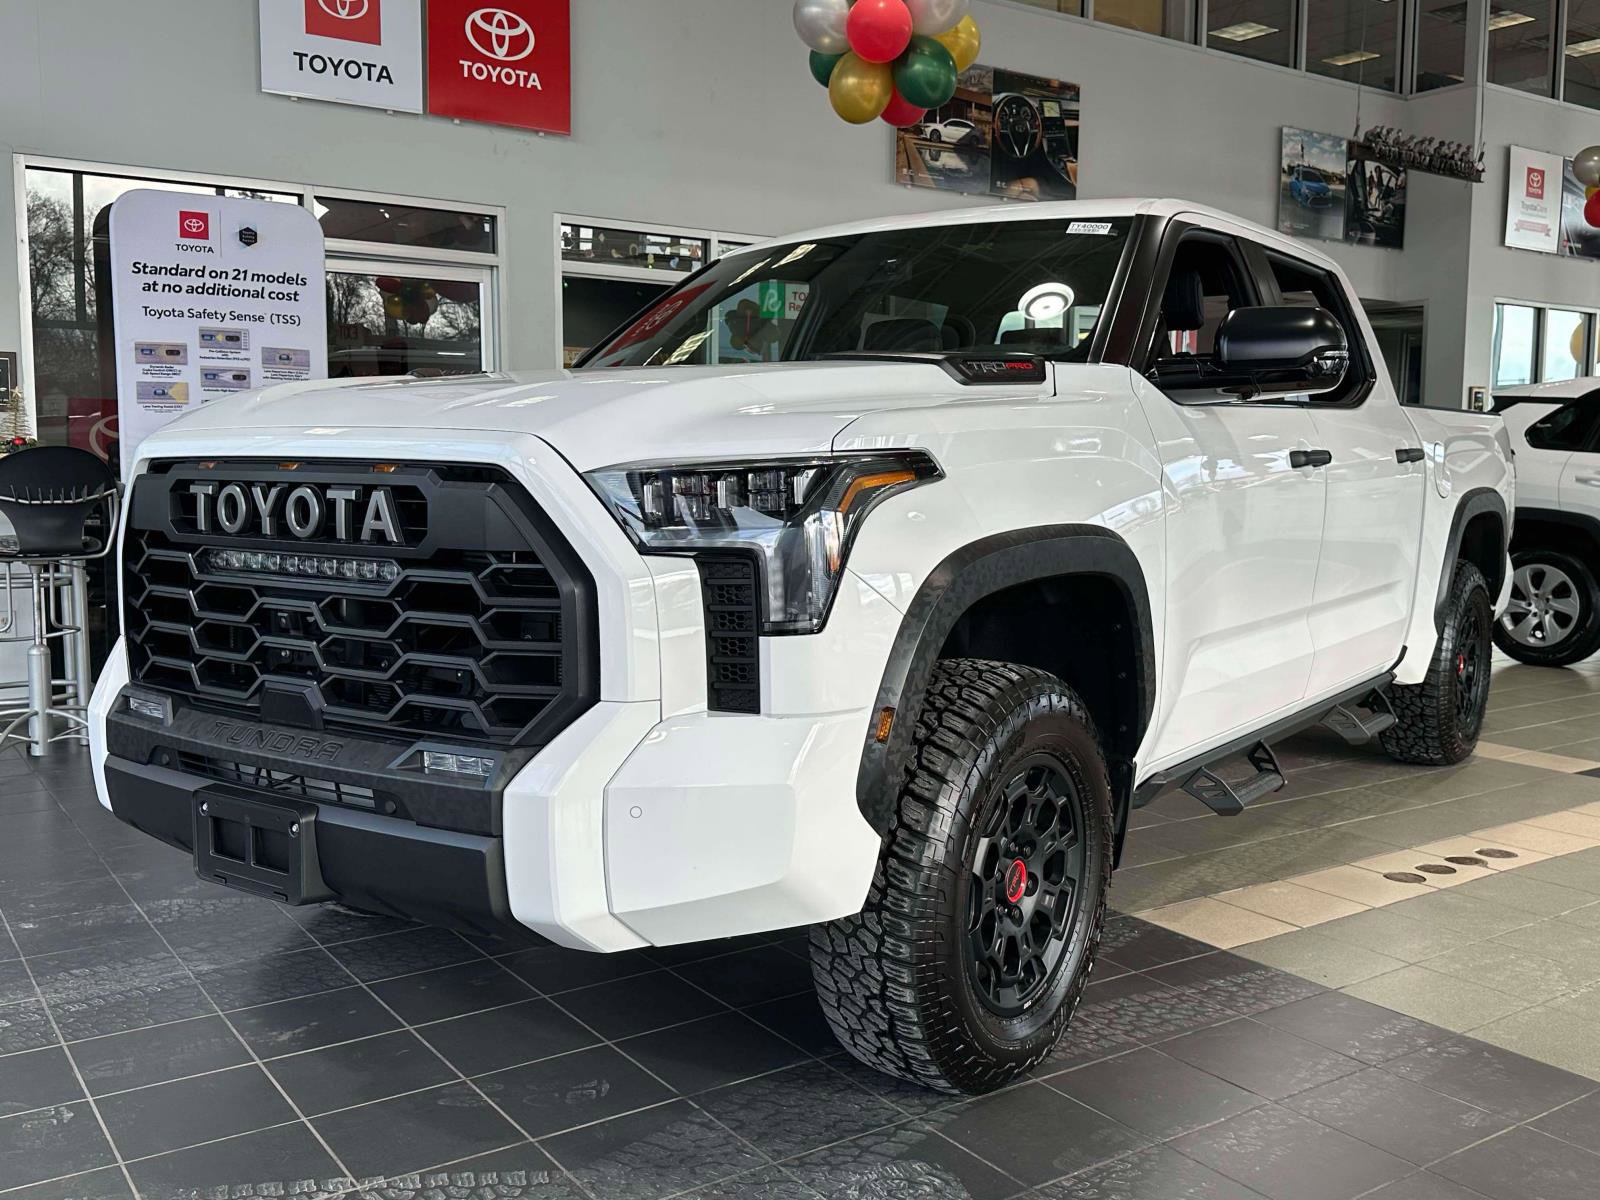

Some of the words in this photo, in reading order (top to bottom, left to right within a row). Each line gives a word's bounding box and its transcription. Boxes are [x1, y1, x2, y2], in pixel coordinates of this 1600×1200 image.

[293, 51, 394, 85] TOYOTA
[459, 60, 543, 90] TOYOTA
[175, 243, 214, 254] TOYOTA
[131, 261, 206, 278] Standard
[209, 268, 229, 280] on
[232, 268, 248, 282] 21
[250, 272, 308, 286] models
[141, 280, 158, 292] at
[162, 283, 183, 294] no
[186, 282, 265, 299] additional
[268, 290, 300, 302] cost
[792, 291, 809, 301] TO
[142, 306, 184, 320] Toyota
[187, 308, 226, 323] Safety
[229, 311, 265, 322] Sense
[270, 313, 301, 327] (TSS)
[190, 482, 403, 543] TOYOTA
[212, 721, 344, 761] TUNDRA
